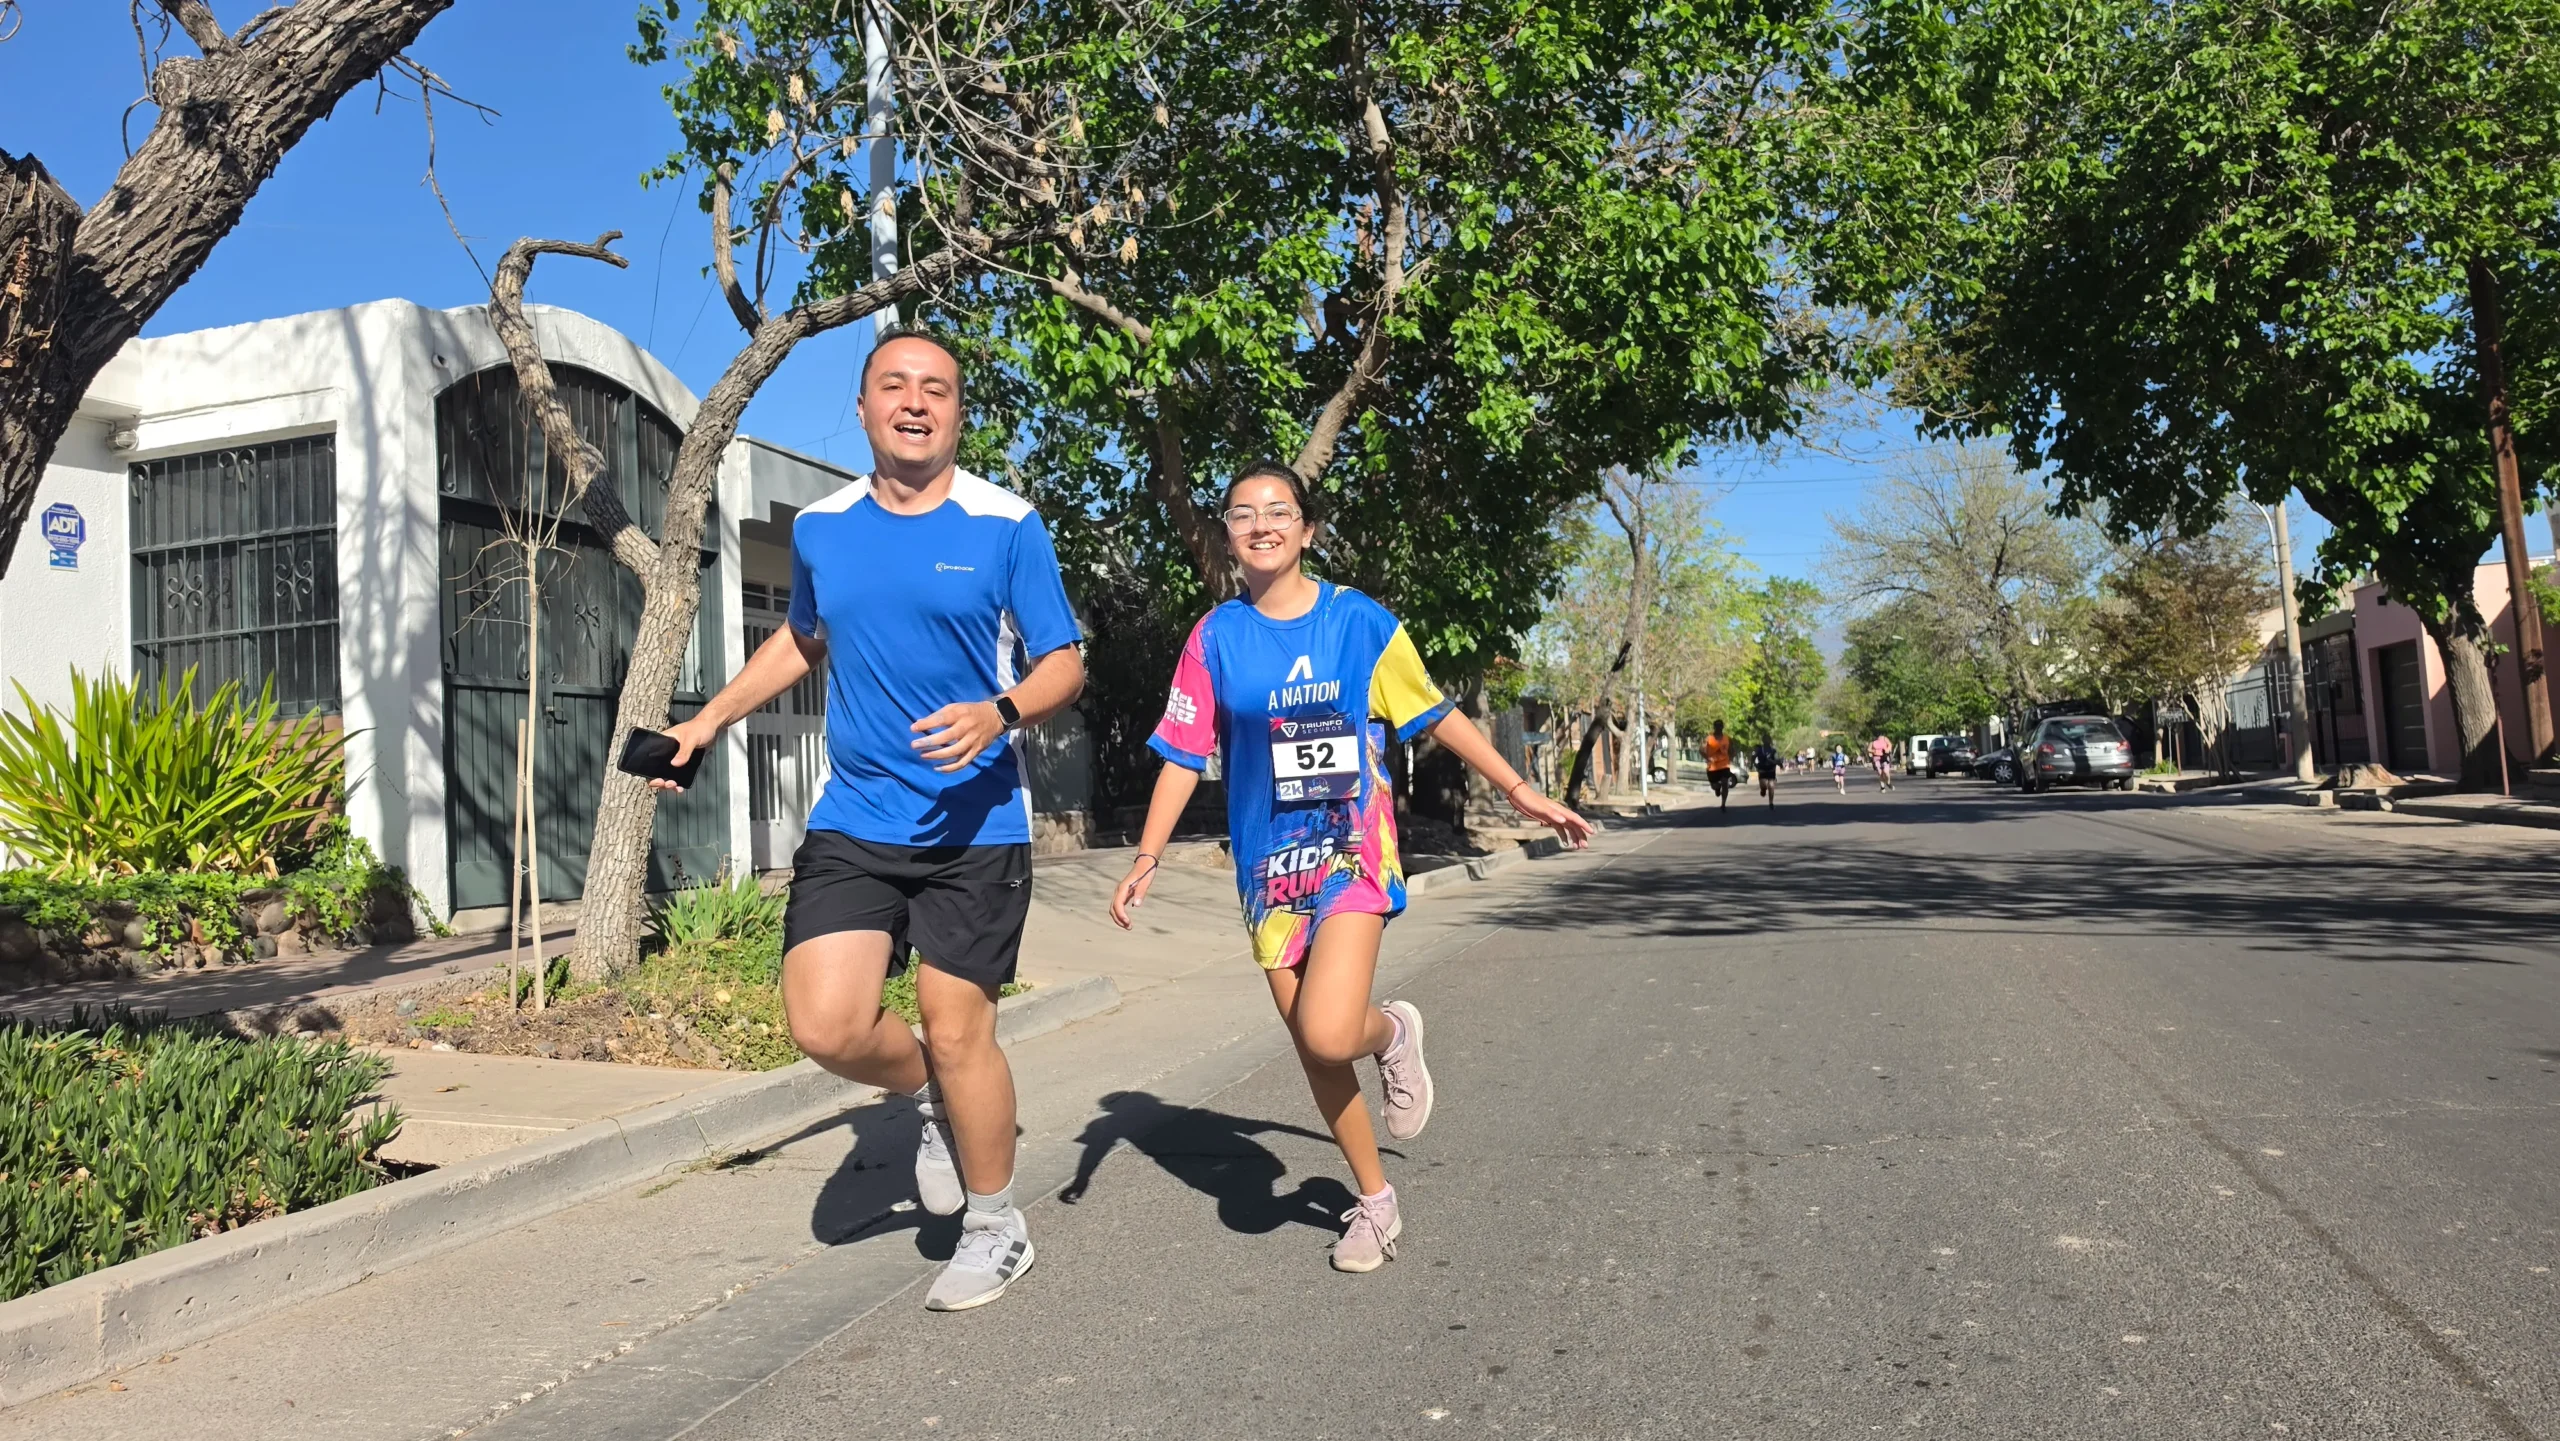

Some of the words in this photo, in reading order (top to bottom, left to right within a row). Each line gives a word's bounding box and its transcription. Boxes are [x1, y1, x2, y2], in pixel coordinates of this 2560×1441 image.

[48, 516, 78, 534] ADT
[1268, 690, 1279, 711] A
[1282, 679, 1340, 708] NATION
[1300, 719, 1343, 729] TRIUNFO
[1302, 726, 1342, 735] SEGUROS
[1296, 742, 1336, 770] 52
[1267, 837, 1335, 878] KIDS
